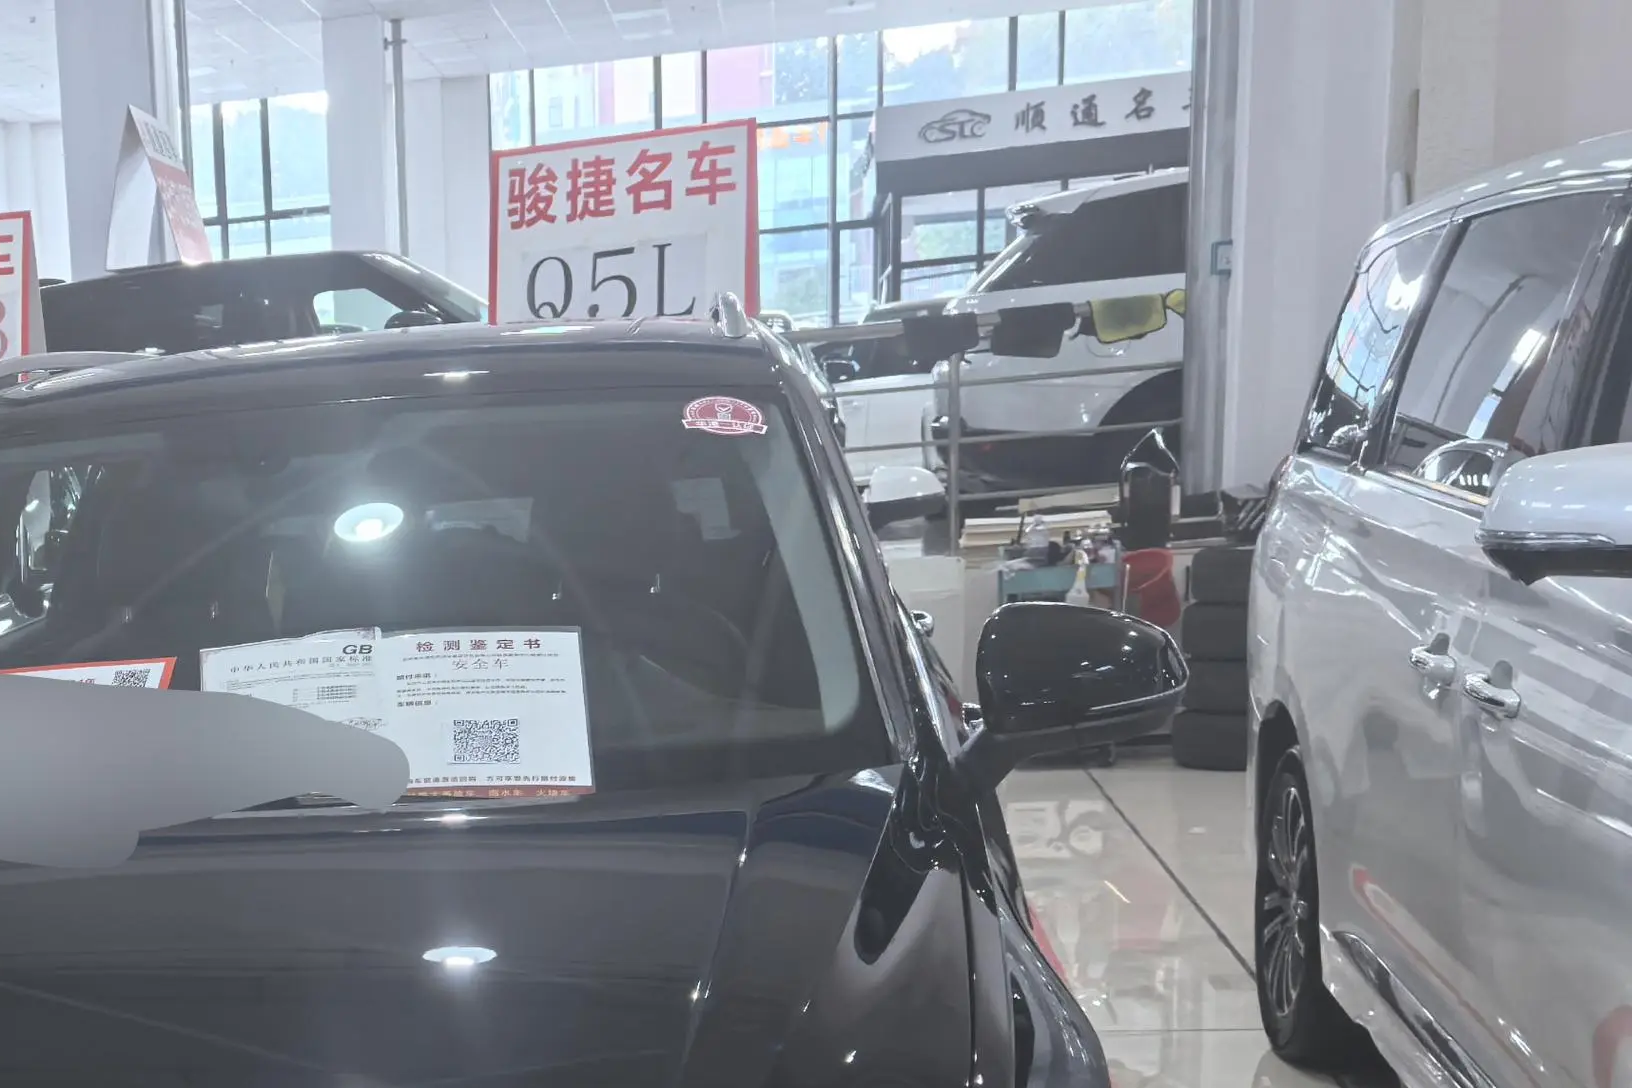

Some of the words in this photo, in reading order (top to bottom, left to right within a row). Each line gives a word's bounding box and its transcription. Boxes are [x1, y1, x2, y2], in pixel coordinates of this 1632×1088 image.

[507, 141, 737, 230] 骏捷名车
[527, 243, 697, 319] Q5L
[342, 644, 373, 655] GB
[416, 638, 541, 652] 检测鉴定书
[452, 658, 509, 671] 安全车
